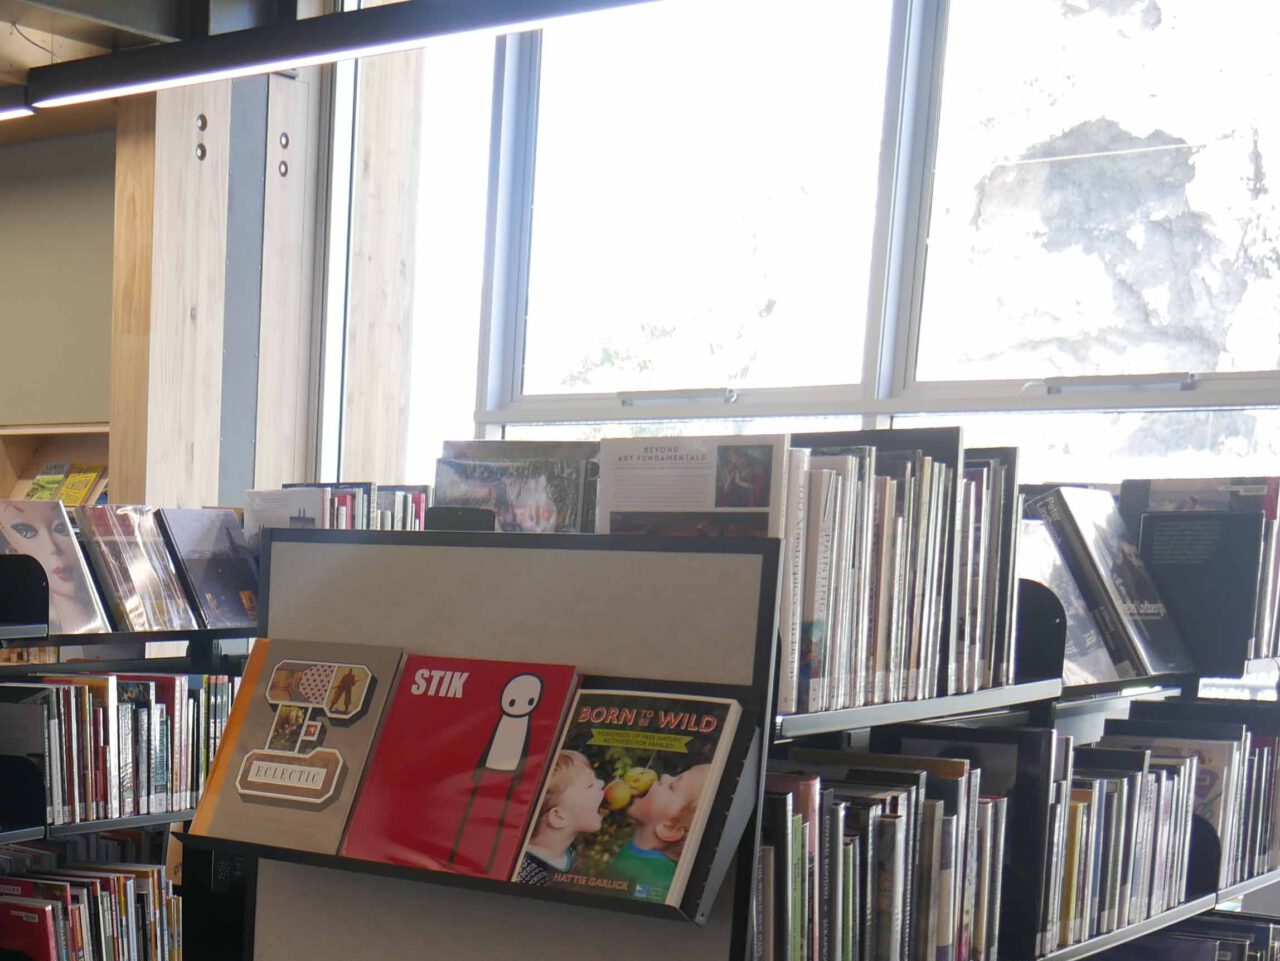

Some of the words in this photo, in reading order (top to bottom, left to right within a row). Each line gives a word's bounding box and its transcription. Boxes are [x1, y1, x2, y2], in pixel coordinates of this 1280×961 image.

[618, 455, 634, 463] ART
[637, 454, 708, 463] FUNDAMENTALS
[643, 446, 680, 455] BEYOND
[1044, 495, 1063, 523] Peter
[818, 532, 832, 614] PAINTING
[410, 668, 470, 698] STIK
[578, 705, 637, 726] BORN
[659, 711, 718, 733] WILD
[640, 709, 655, 718] TO
[255, 766, 322, 784] ECLECTIC
[553, 872, 587, 885] HATTIE
[589, 877, 629, 891] GARLICK
